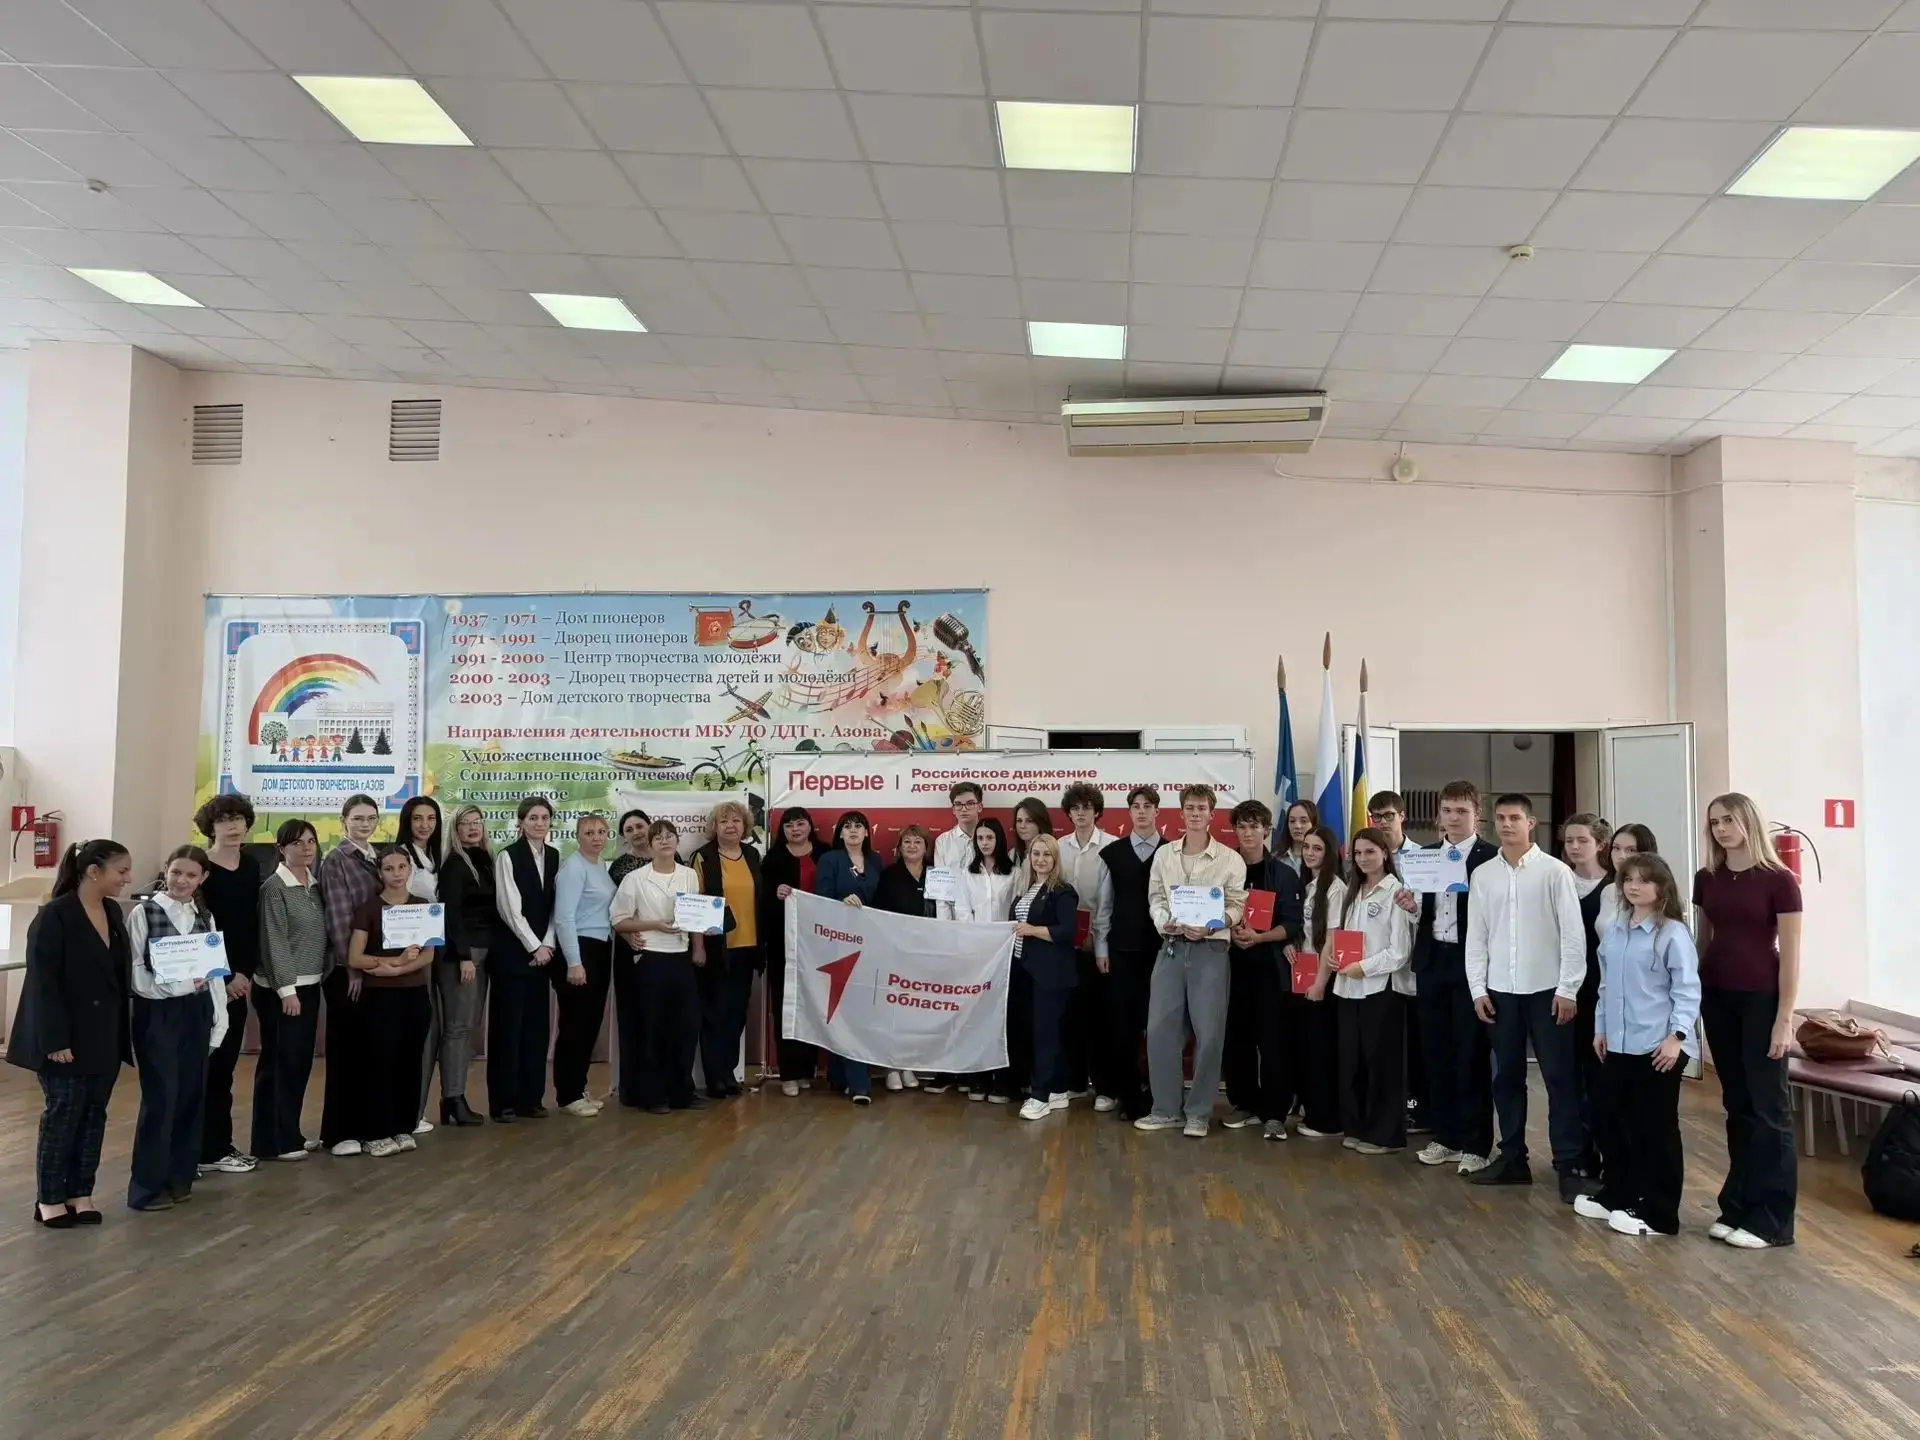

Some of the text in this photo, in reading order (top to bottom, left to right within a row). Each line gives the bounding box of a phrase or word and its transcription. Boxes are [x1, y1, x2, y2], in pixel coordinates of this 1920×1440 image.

[452, 614, 488, 627] 1937
[504, 614, 537, 627] 1971
[555, 611, 588, 625] Дом
[592, 613, 665, 626] пионеров
[451, 634, 485, 647] 1971
[502, 634, 536, 646] 1991
[555, 631, 611, 646] Дворец
[615, 633, 688, 645] пионеров
[451, 654, 486, 666] 1991
[501, 654, 545, 664] 2000
[563, 651, 612, 666] Центр
[615, 652, 699, 665] творчества
[703, 650, 781, 664] молодёжи
[450, 674, 494, 684] 2000
[508, 674, 551, 686] 2003
[569, 671, 626, 686] Дворец
[629, 672, 713, 685] творчества
[717, 670, 760, 684] детей
[764, 673, 773, 683] и
[778, 670, 856, 684] молодёжи
[460, 693, 502, 706] 2003
[521, 691, 553, 705] Дом
[557, 692, 624, 705] детского
[628, 692, 711, 705] творчества
[447, 725, 888, 740] Направления деятельности МБУ ДО ДДТ г. Азова:
[459, 749, 602, 764] Художественное
[459, 769, 694, 783] Социально-педагогическое
[911, 768, 1098, 780] Российское движение
[262, 779, 278, 791] ДОМ
[279, 779, 315, 791] ДЕТСКОГО
[316, 779, 360, 791] ТВОРЧЕСТВА
[788, 770, 885, 797] Первые
[459, 788, 569, 800] Техническое
[814, 923, 864, 945] Первые
[887, 973, 992, 996] Ростовская
[886, 993, 960, 1012] область
